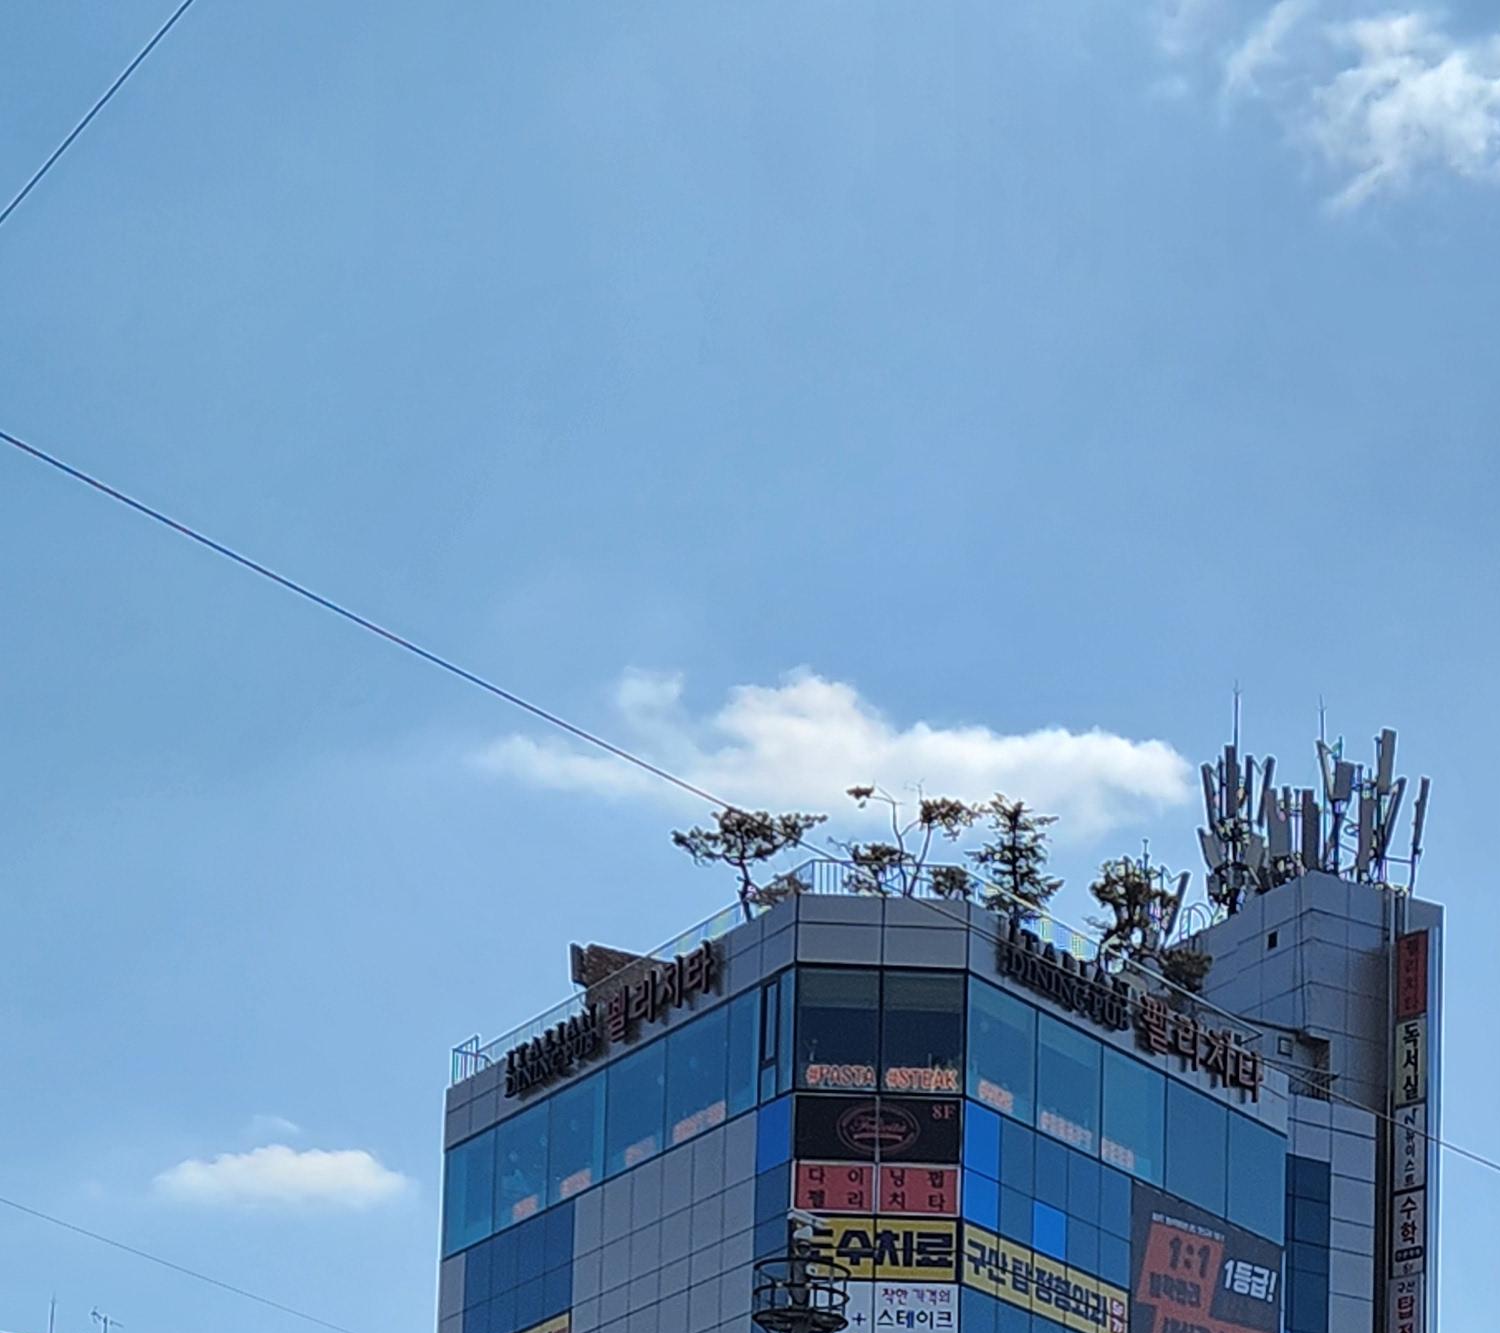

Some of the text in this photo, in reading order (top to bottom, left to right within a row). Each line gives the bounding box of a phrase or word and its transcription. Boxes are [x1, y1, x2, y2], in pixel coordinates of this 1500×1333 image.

[806, 1064, 958, 1091] #PASTA #STEAK
[1402, 1021, 1420, 1101] 독서실
[932, 1103, 956, 1120] 8F
[1400, 1196, 1417, 1244] 수학
[804, 1227, 954, 1268] 도수치료
[1223, 1258, 1277, 1304] 1등급!
[876, 1309, 954, 1331] 스테이크
